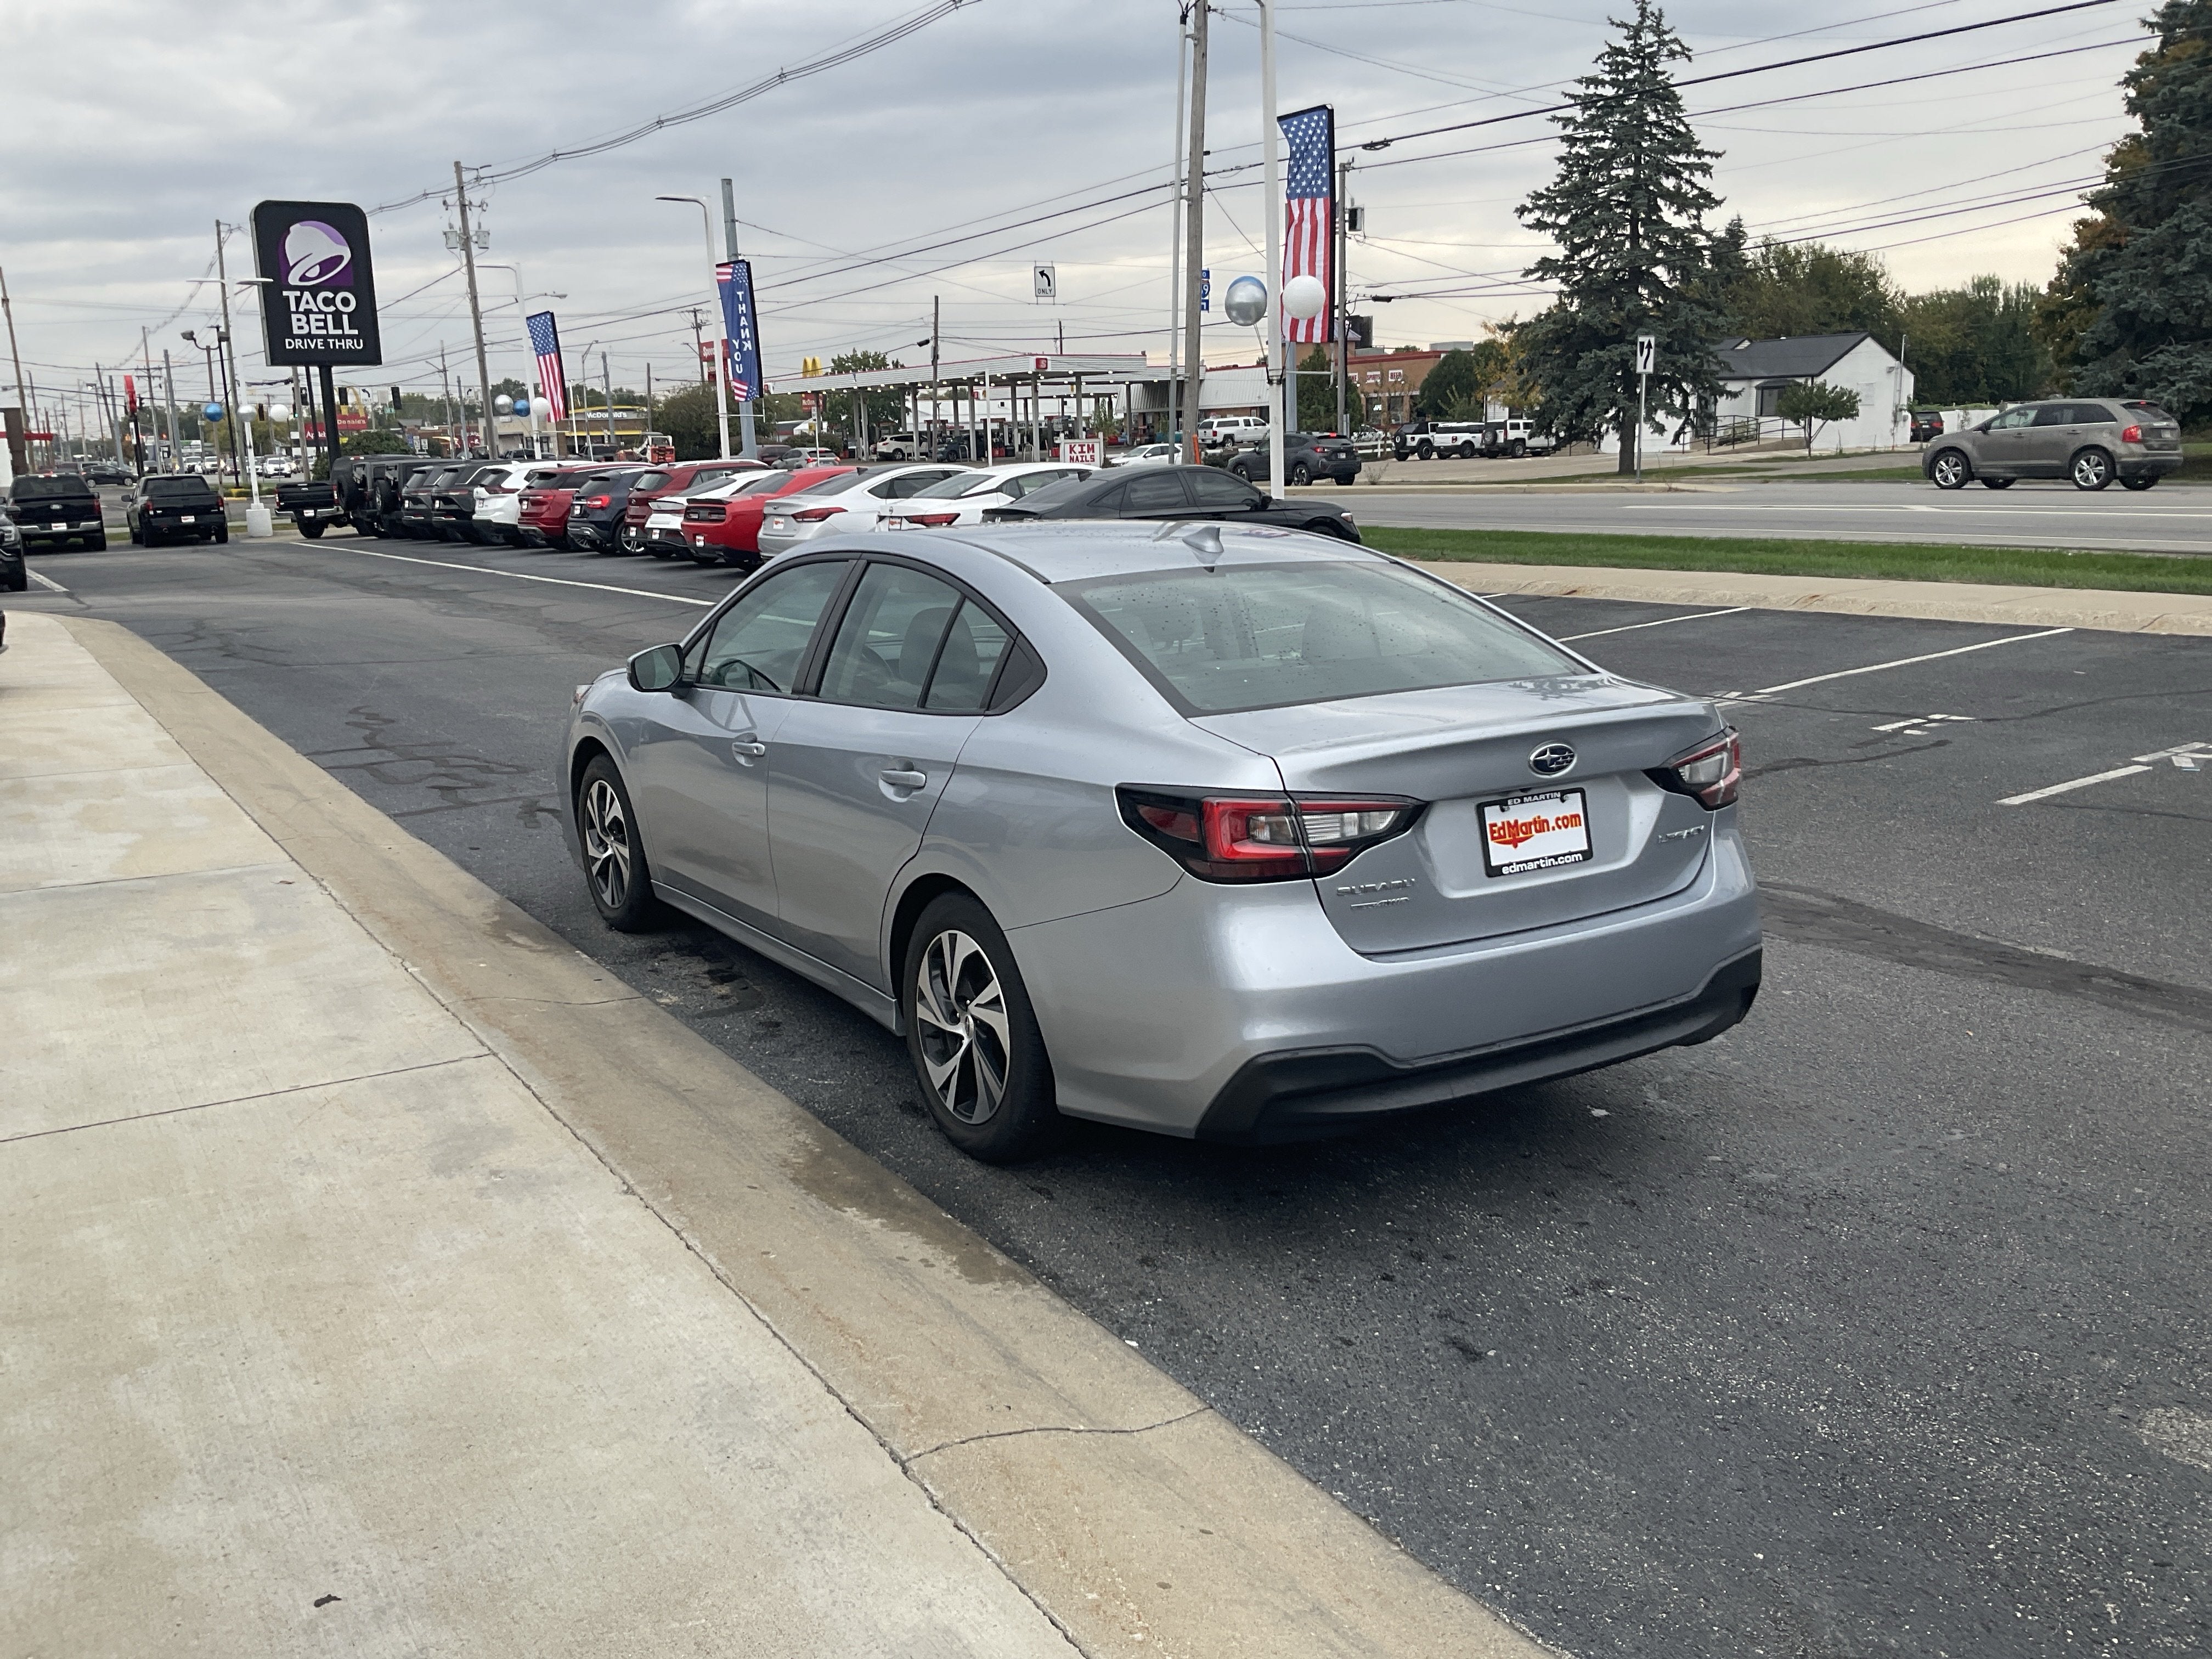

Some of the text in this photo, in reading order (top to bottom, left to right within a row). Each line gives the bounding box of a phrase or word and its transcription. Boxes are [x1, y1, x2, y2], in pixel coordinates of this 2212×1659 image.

[282, 291, 357, 313] TACO
[291, 313, 359, 335] BELL
[285, 338, 363, 349] DRIVE THRU
[1069, 443, 1095, 454] KIM
[1069, 455, 1095, 463] NAILS
[1523, 791, 1561, 803] MARTIN
[1488, 813, 1582, 845] EdMartin.com
[1502, 853, 1583, 874] edmartin.com
